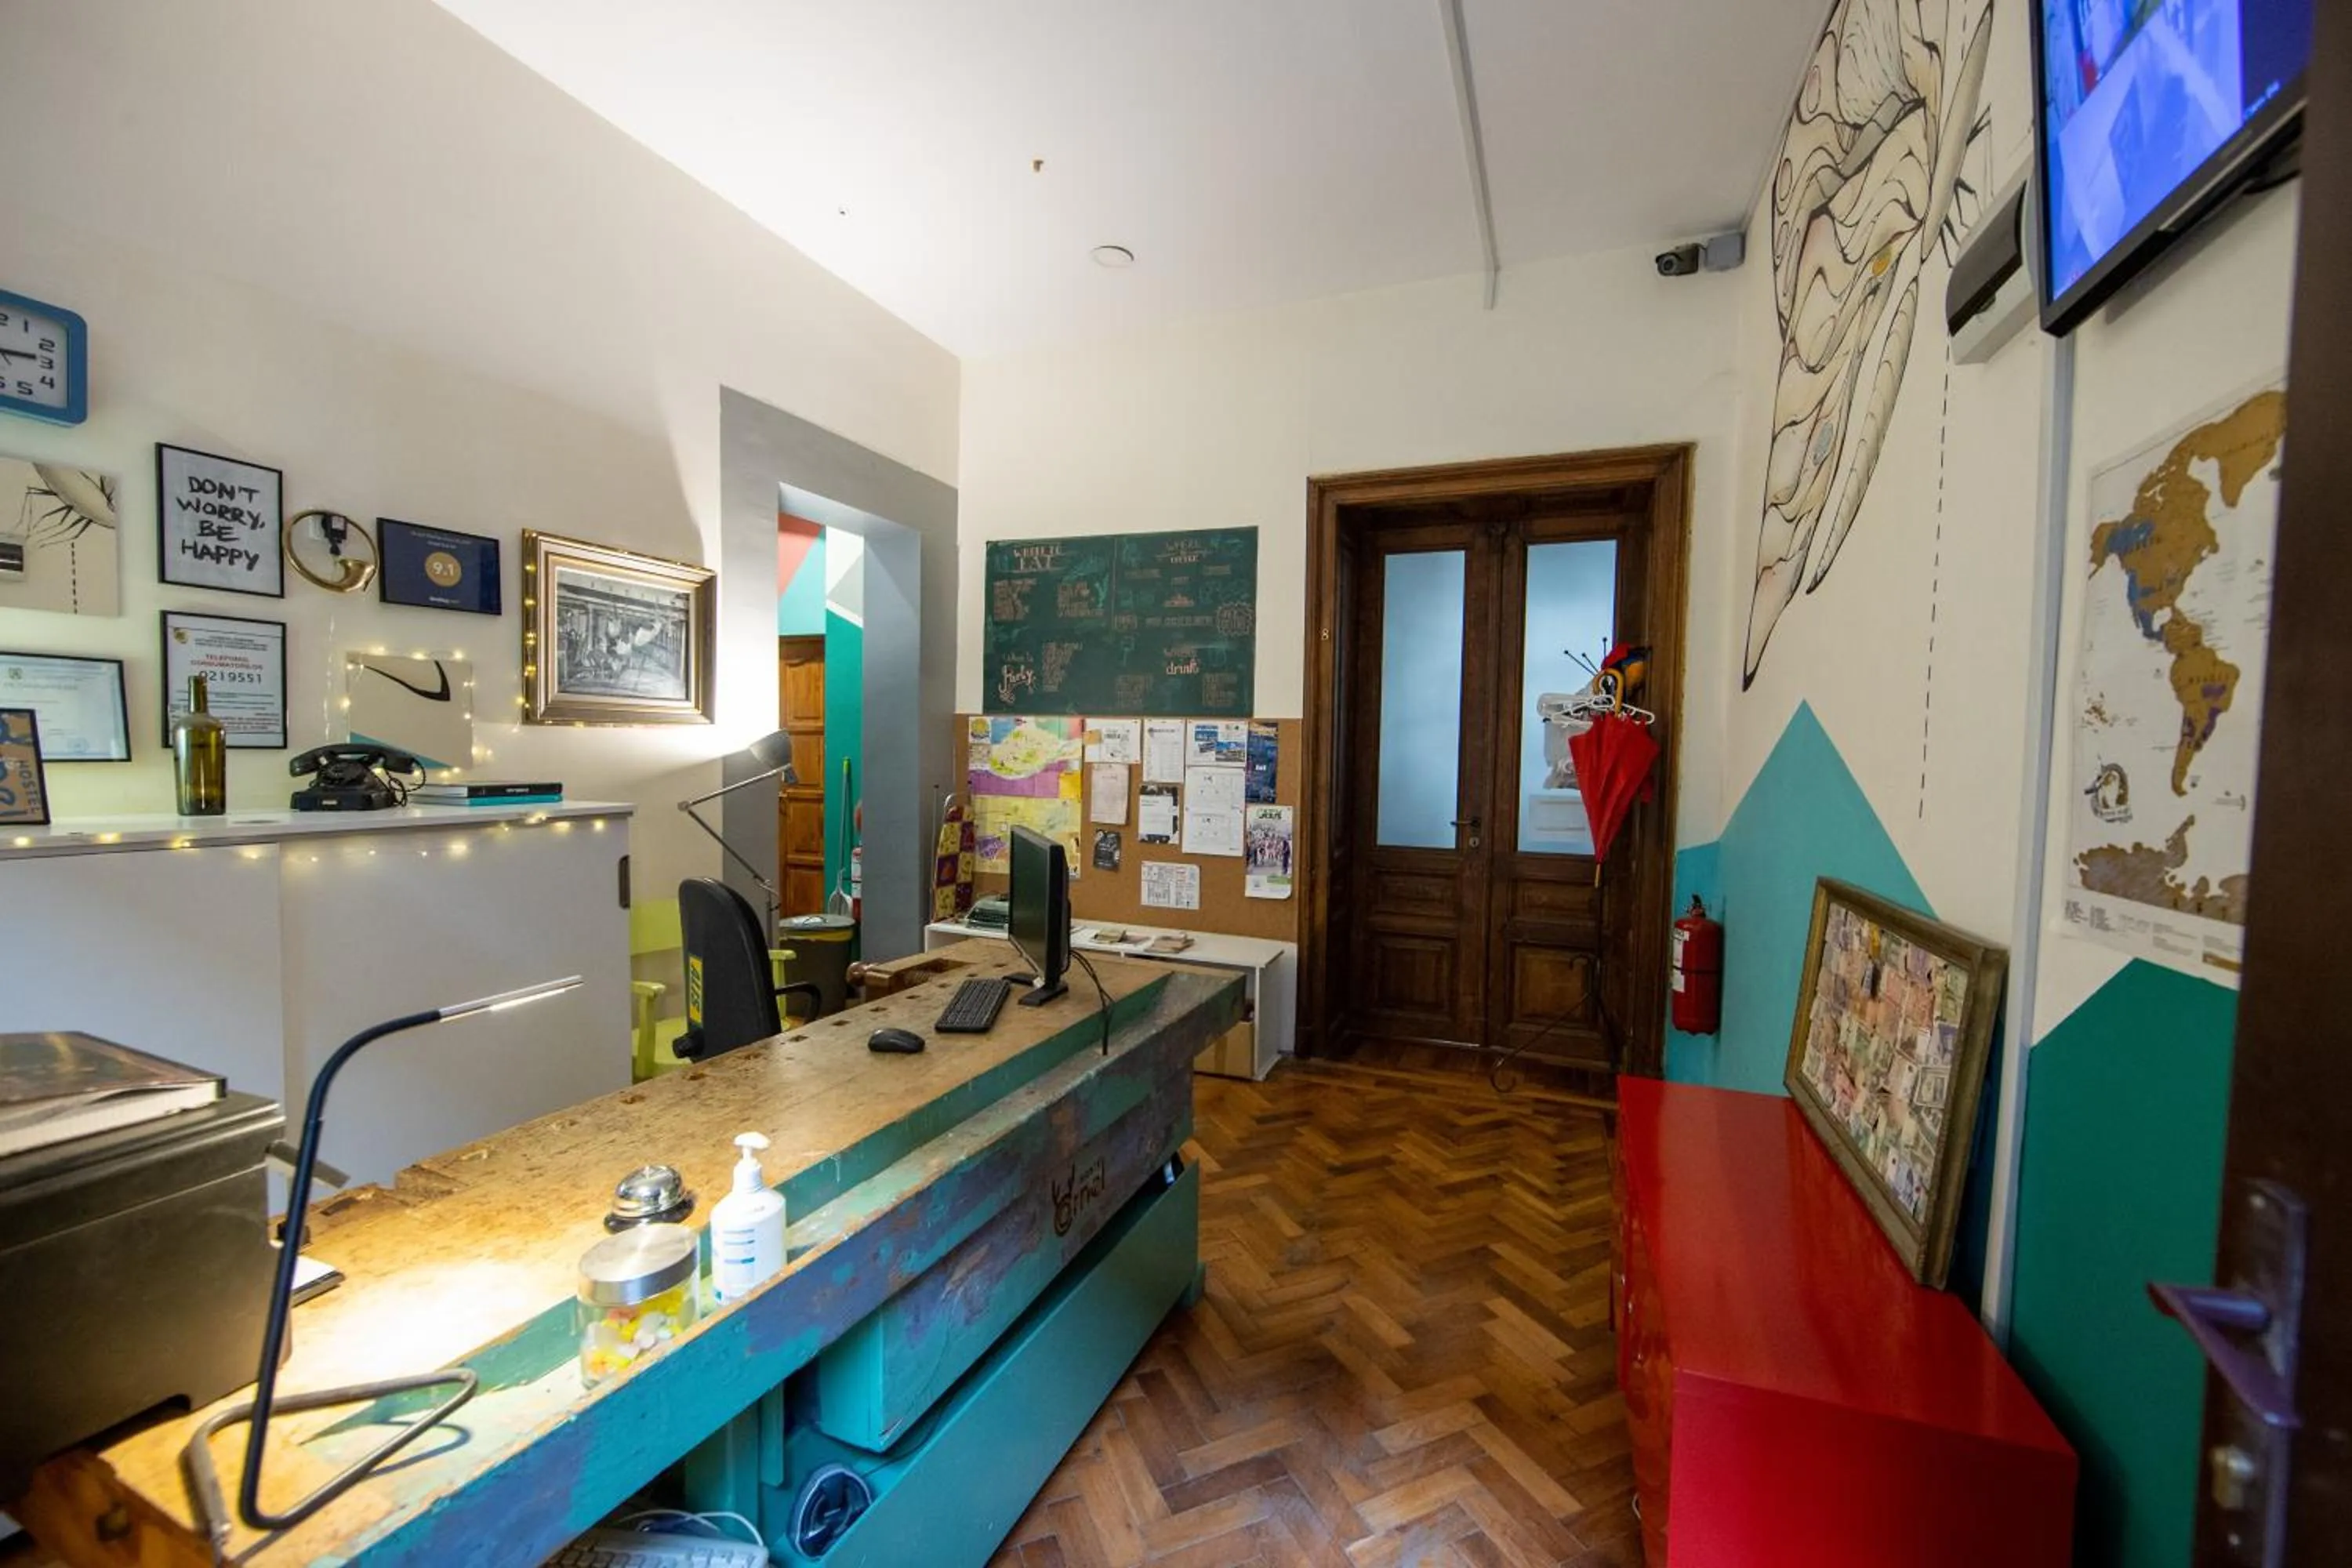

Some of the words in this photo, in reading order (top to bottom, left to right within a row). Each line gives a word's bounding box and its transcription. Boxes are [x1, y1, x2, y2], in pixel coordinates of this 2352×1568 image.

[24, 318, 29, 333] 1
[38, 338, 56, 353] 2
[38, 355, 54, 370] 3
[16, 380, 34, 396] 5
[39, 376, 55, 390] 4
[187, 475, 261, 504] DON'T
[176, 495, 266, 531] WORRY,
[197, 519, 241, 542] BE
[180, 538, 260, 572] HAPPY
[432, 561, 456, 577] 9.1
